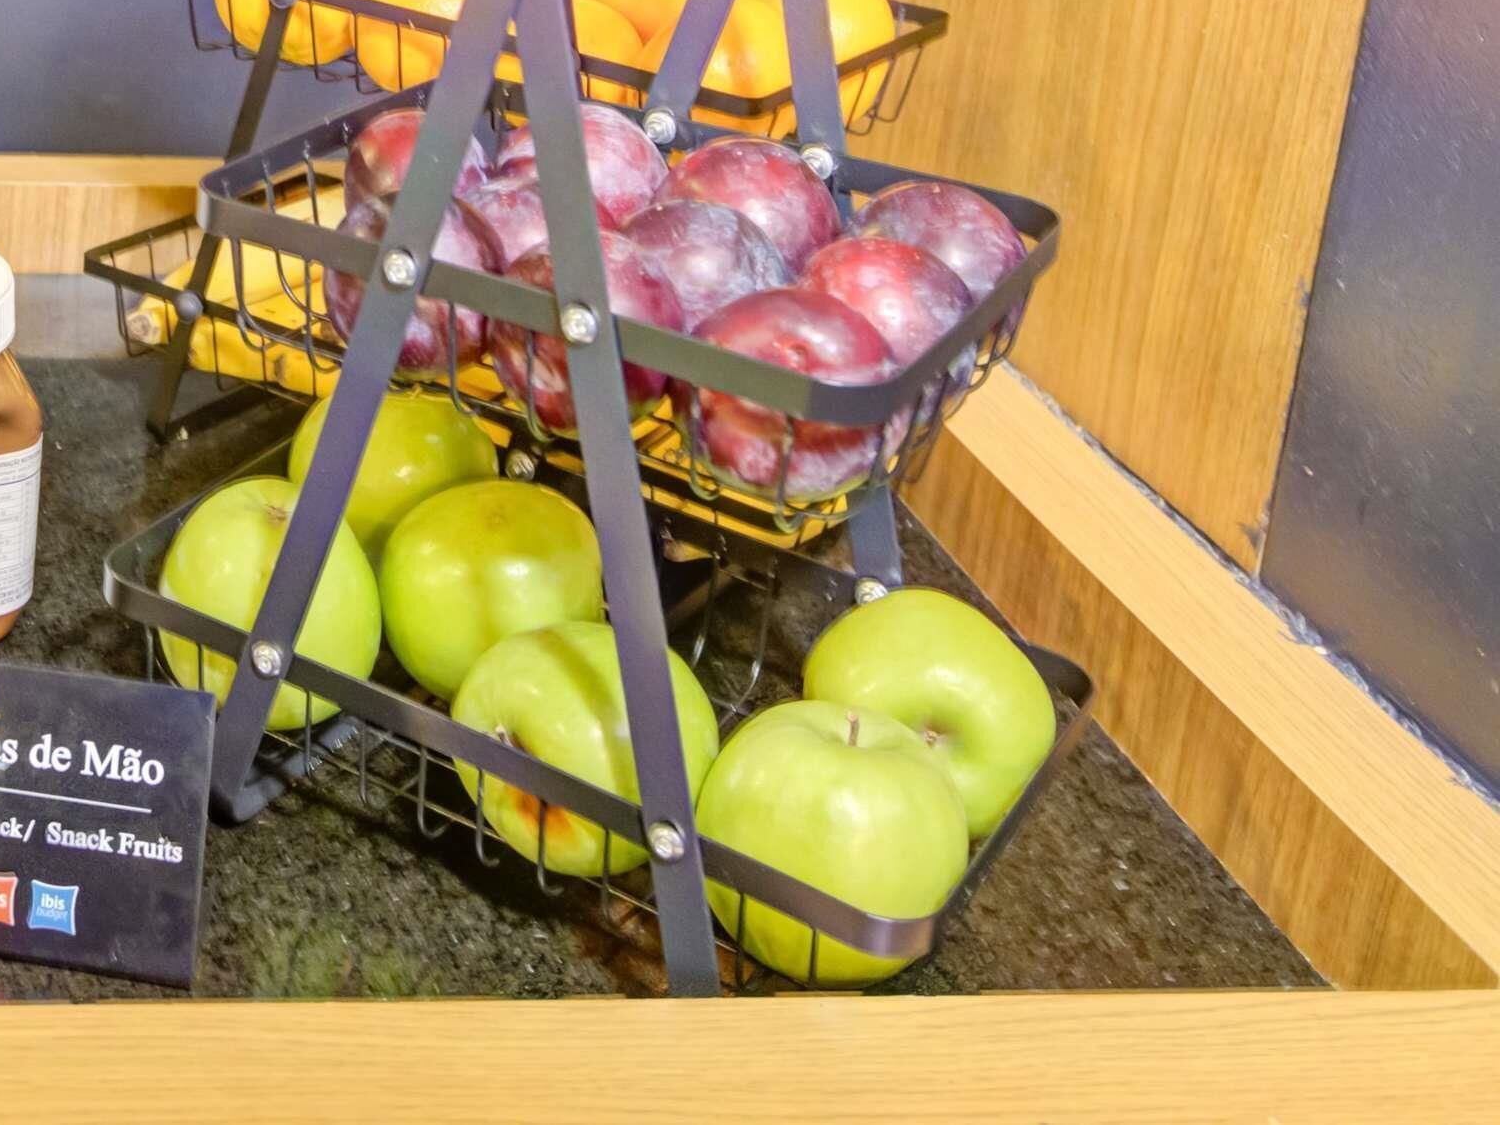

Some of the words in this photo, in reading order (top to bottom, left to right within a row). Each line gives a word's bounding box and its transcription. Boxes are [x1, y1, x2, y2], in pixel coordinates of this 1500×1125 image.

[29, 734, 72, 772] de
[80, 739, 165, 786] Mão
[46, 821, 114, 853] Snack
[117, 832, 184, 863] Fruits
[40, 892, 66, 911] ibis
